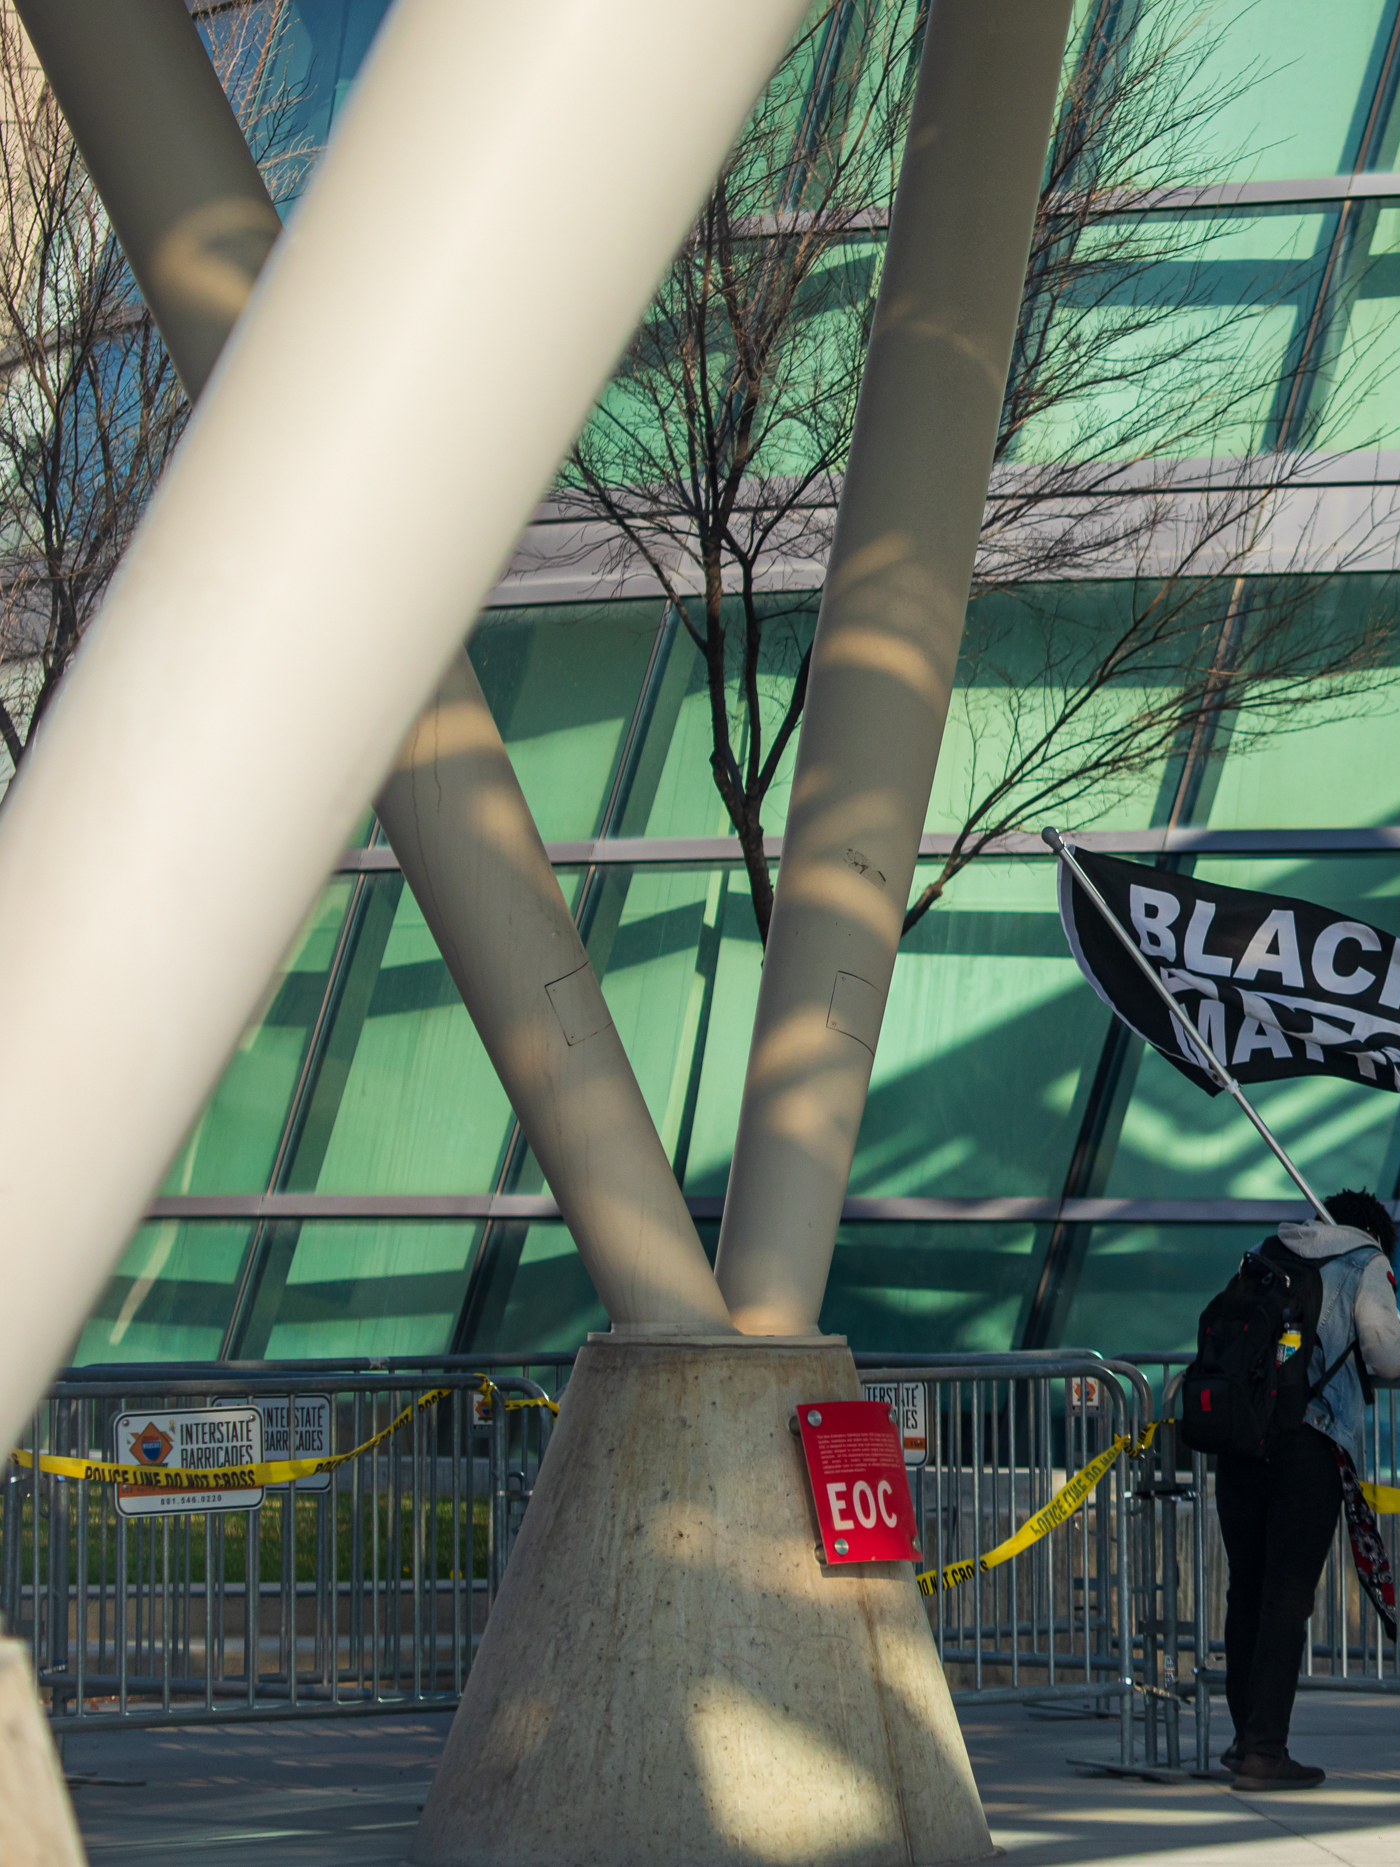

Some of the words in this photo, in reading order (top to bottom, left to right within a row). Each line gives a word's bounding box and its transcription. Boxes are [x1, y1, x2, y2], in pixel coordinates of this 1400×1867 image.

[180, 1420, 253, 1446] INTERSTATE
[181, 1444, 253, 1469] BARRICADES
[85, 1466, 129, 1484] POLICE
[133, 1470, 161, 1485] LINE
[164, 1472, 183, 1488] DO
[186, 1473, 210, 1488] NOT
[213, 1469, 256, 1488] CROSS
[826, 1480, 898, 1531] EOC
[930, 1571, 948, 1592] NT
[951, 1560, 989, 1586] CROS
